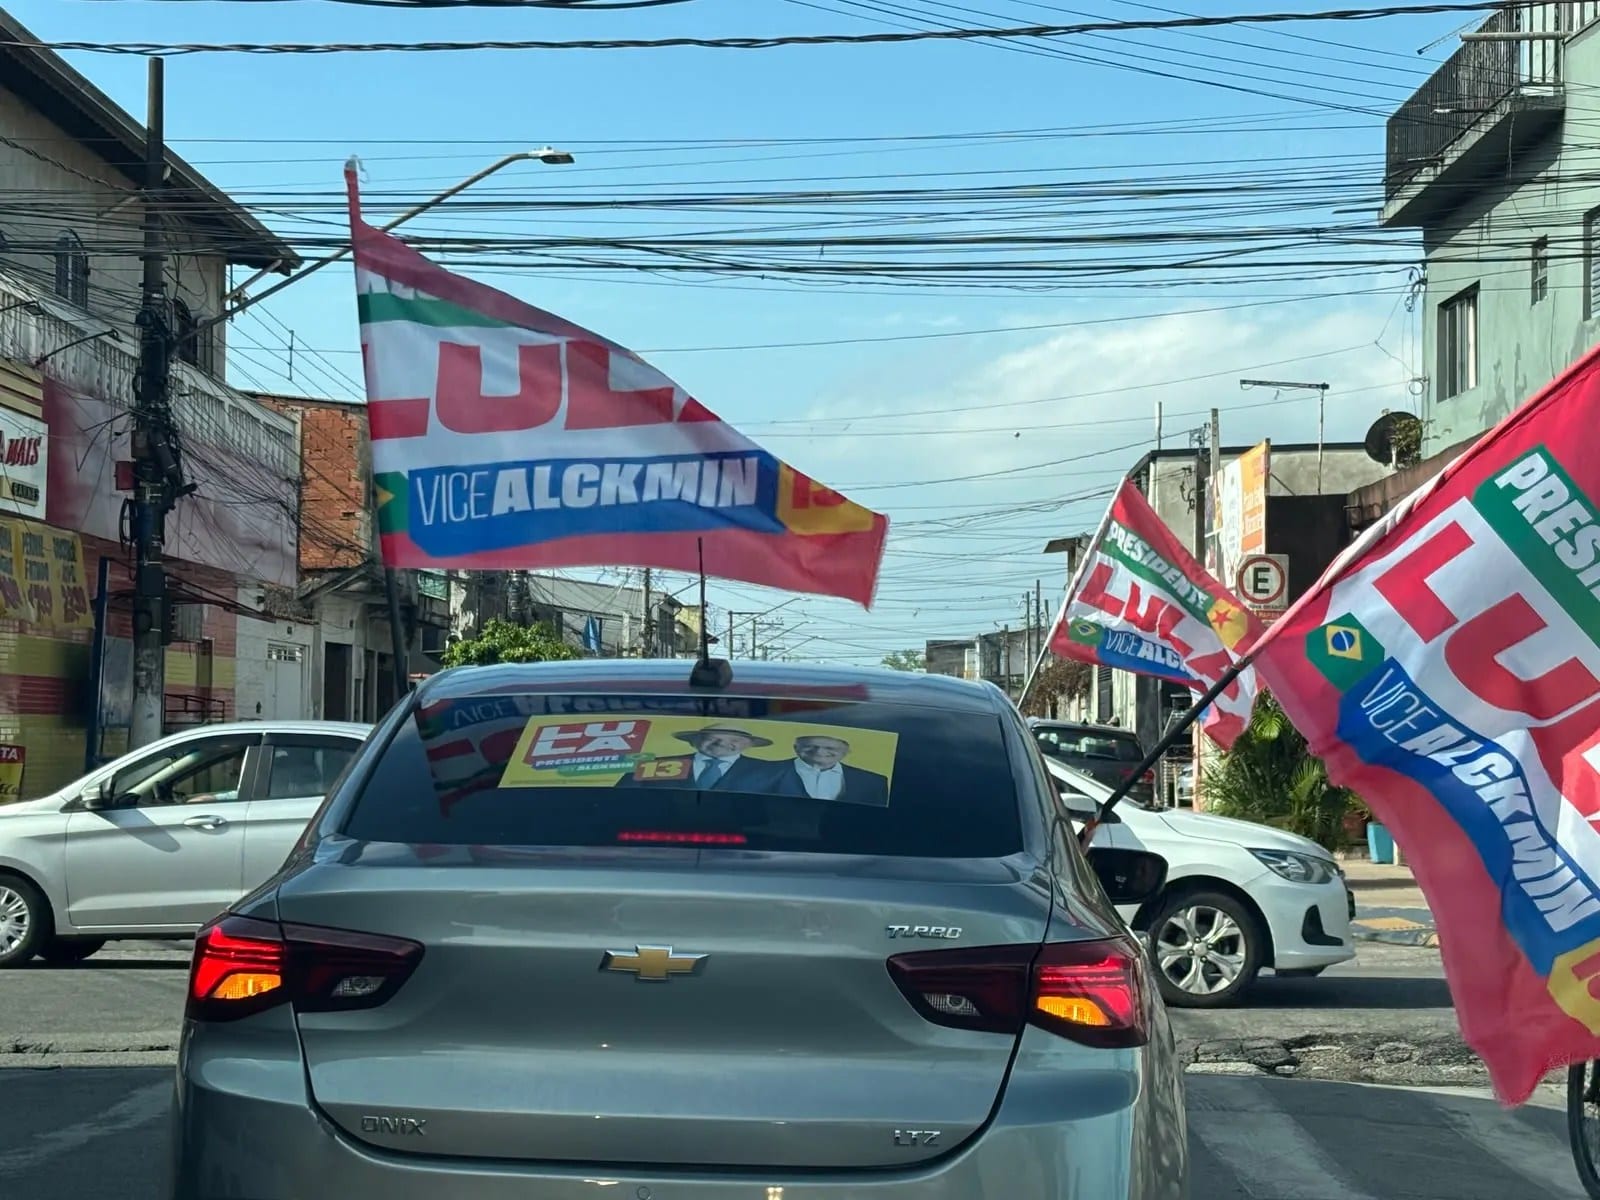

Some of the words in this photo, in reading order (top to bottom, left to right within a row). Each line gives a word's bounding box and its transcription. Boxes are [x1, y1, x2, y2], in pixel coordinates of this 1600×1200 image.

[6, 436, 41, 466] MAIS
[415, 469, 491, 526] VICE
[492, 456, 758, 516] ALCKMIN
[1252, 566, 1270, 594] E
[1107, 629, 1140, 657] VICE
[1360, 668, 1438, 744] VICE
[535, 754, 620, 767] PRESIDENTE
[639, 760, 684, 778] 13
[1398, 722, 1600, 933] ALCKMIN
[886, 925, 962, 939] TURBO
[361, 1115, 426, 1136] ONIX
[894, 1129, 941, 1146] LTZ
